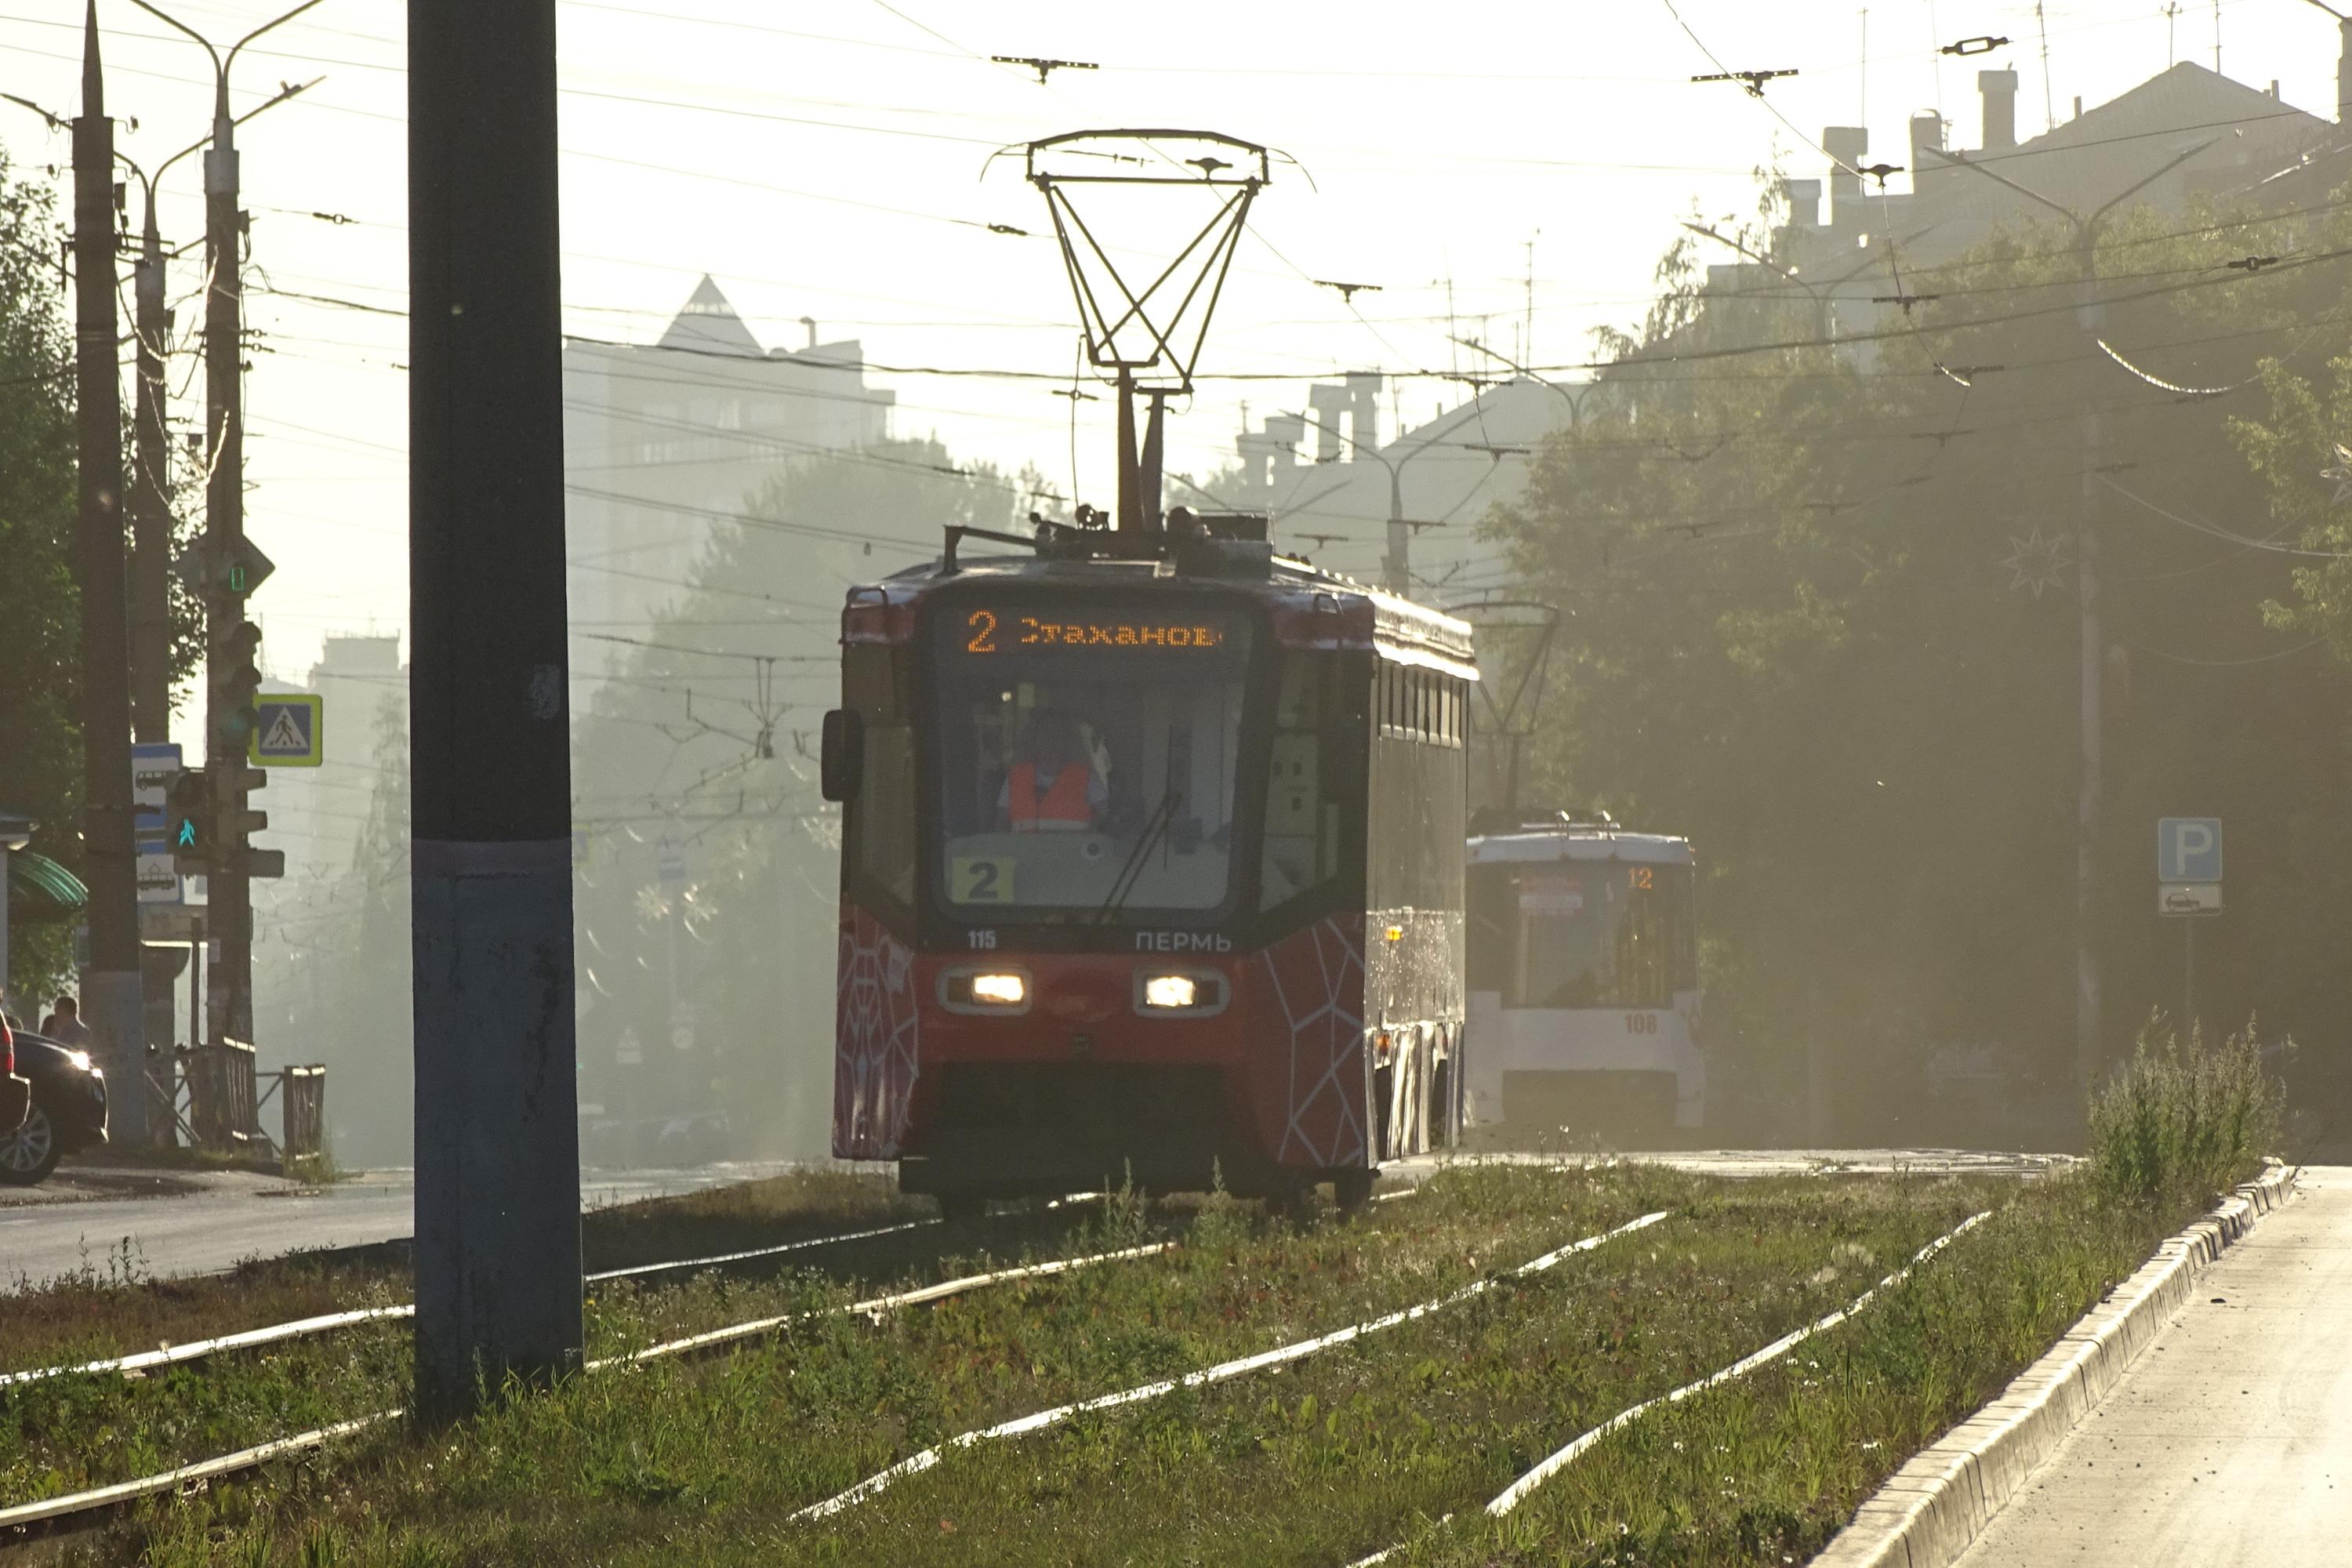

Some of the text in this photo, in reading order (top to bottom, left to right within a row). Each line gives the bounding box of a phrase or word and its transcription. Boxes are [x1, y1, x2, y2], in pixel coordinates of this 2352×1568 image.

[967, 610, 996, 652] 2
[967, 862, 999, 900] 2
[1628, 866, 1653, 890] 12
[967, 930, 996, 949] 115
[1135, 931, 1232, 952] ПЕРМЬ
[1624, 1013, 1657, 1035] 108
